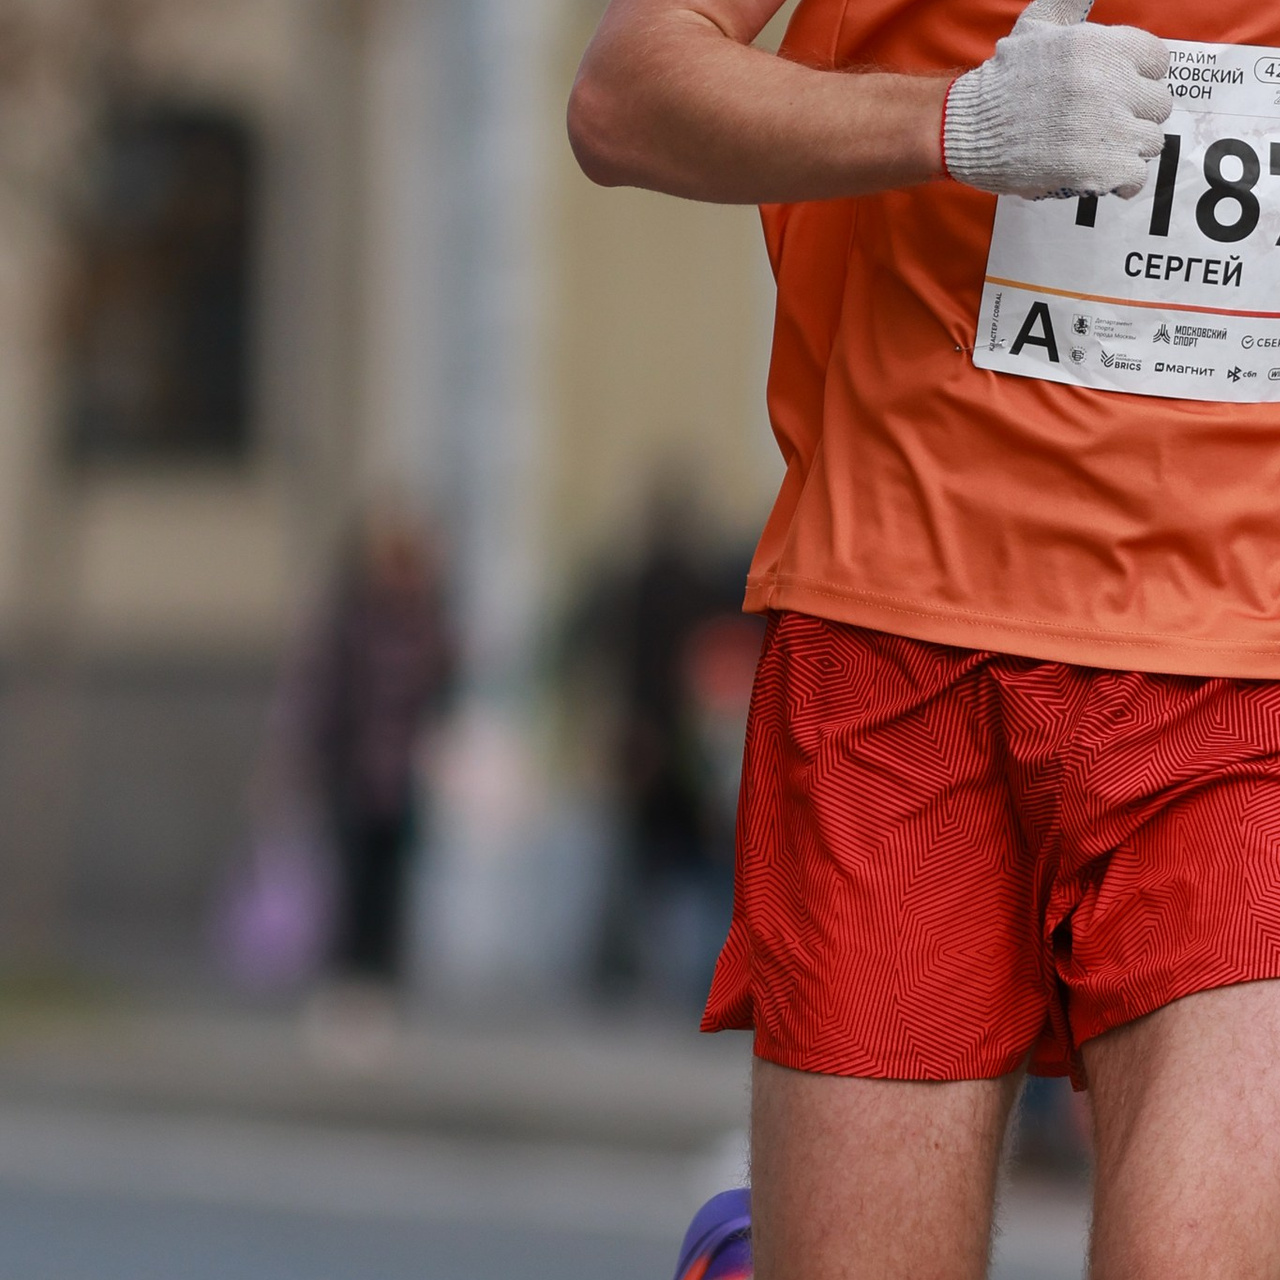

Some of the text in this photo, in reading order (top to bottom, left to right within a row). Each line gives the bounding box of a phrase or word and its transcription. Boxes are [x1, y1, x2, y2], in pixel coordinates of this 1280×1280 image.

[1164, 66, 1244, 85] КОВСКИЙ
[1124, 251, 1243, 287] СЕРГЕЙ
[1009, 301, 1060, 363] A
[1174, 324, 1228, 340] МОСКОВСКИЙ
[1173, 335, 1199, 348] СПОРТ
[1114, 361, 1142, 372] BRICS
